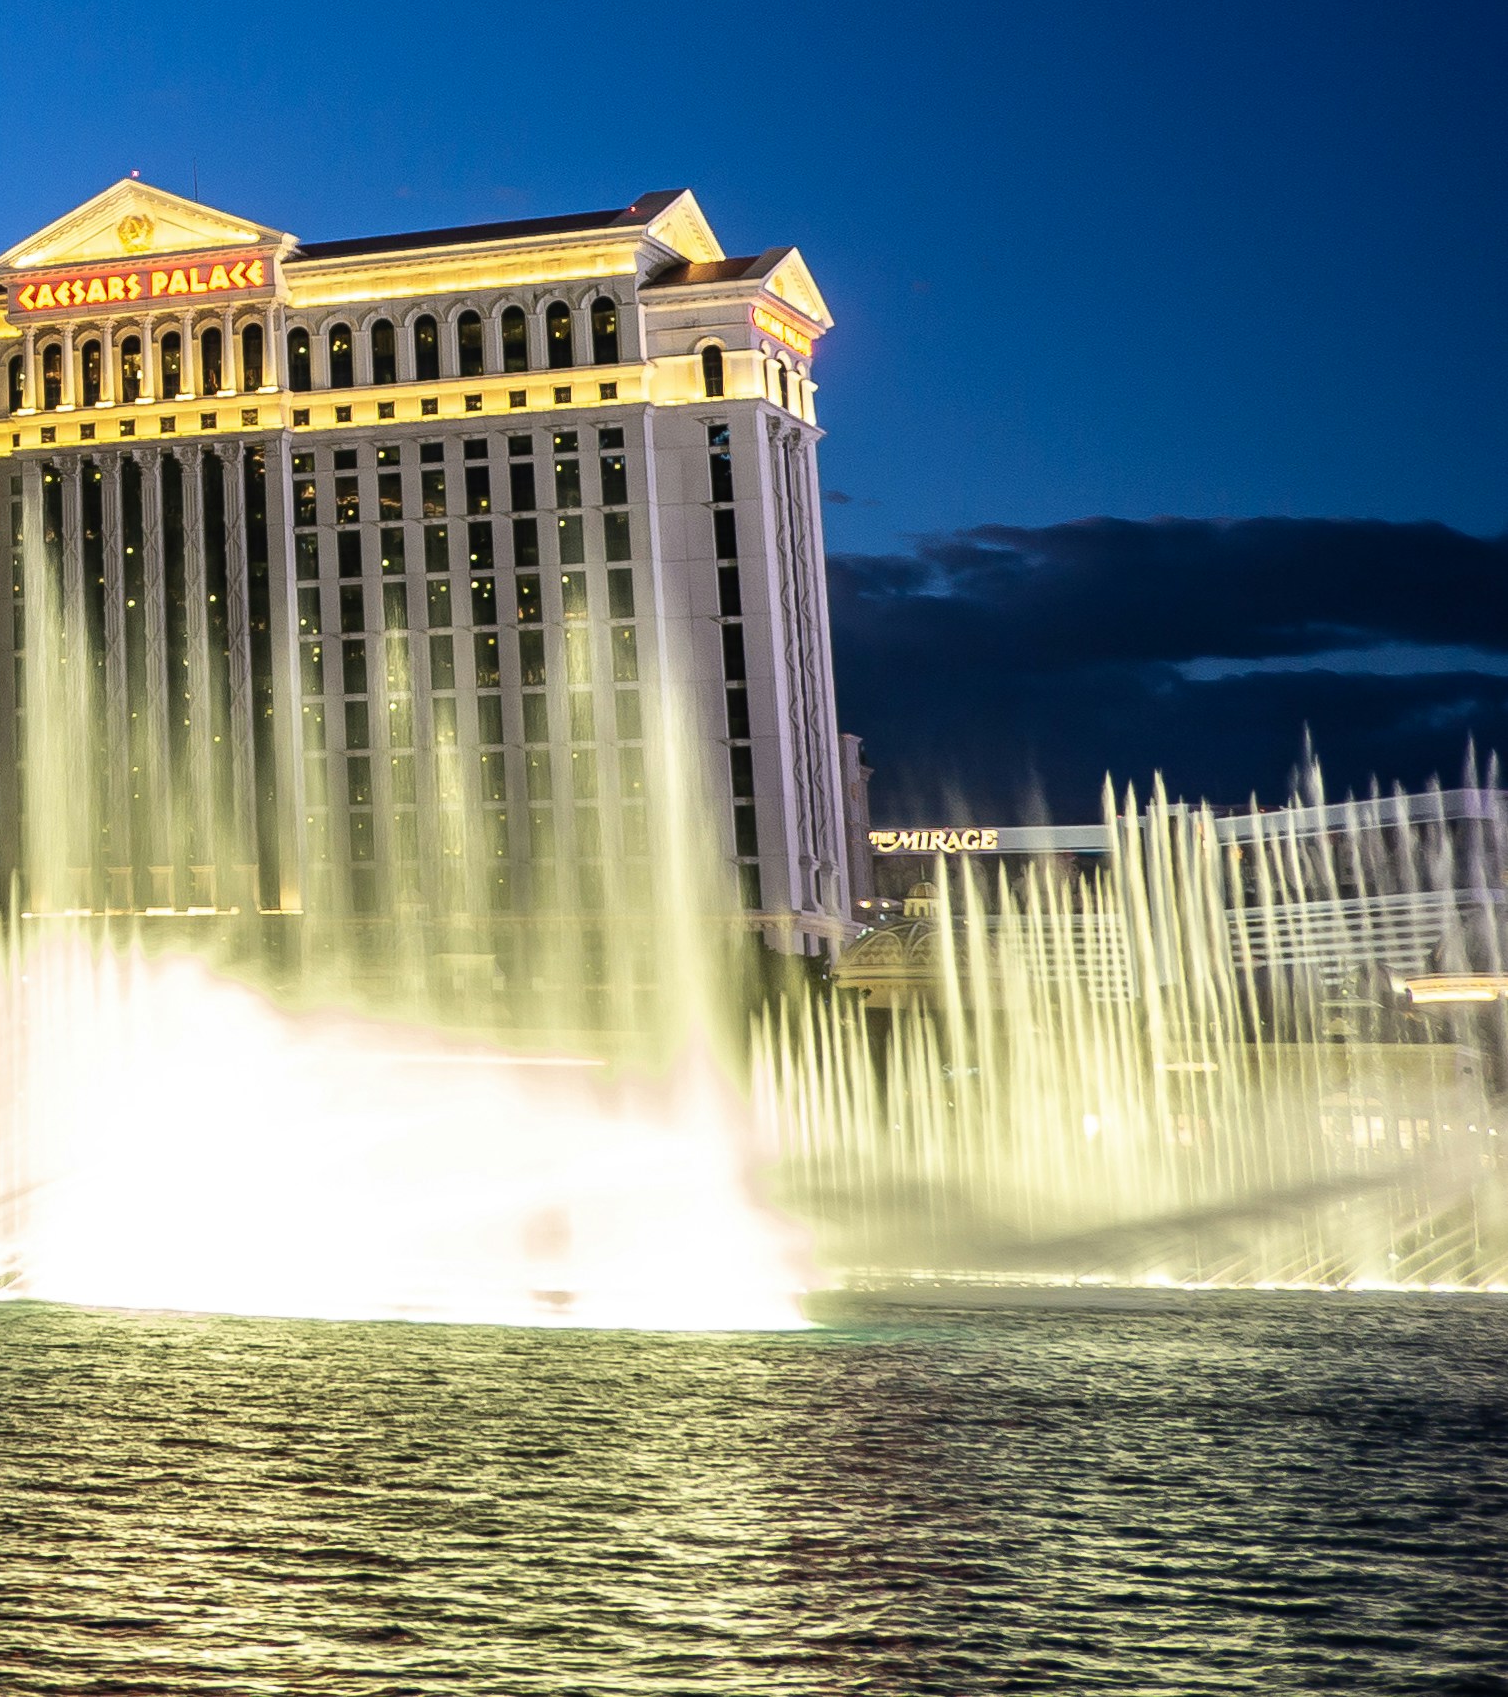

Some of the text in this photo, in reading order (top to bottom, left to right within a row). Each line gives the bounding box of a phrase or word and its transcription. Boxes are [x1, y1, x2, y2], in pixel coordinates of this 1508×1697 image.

[18, 259, 264, 310] CAESARS PALACE
[868, 829, 998, 853] THE MIRAGE
